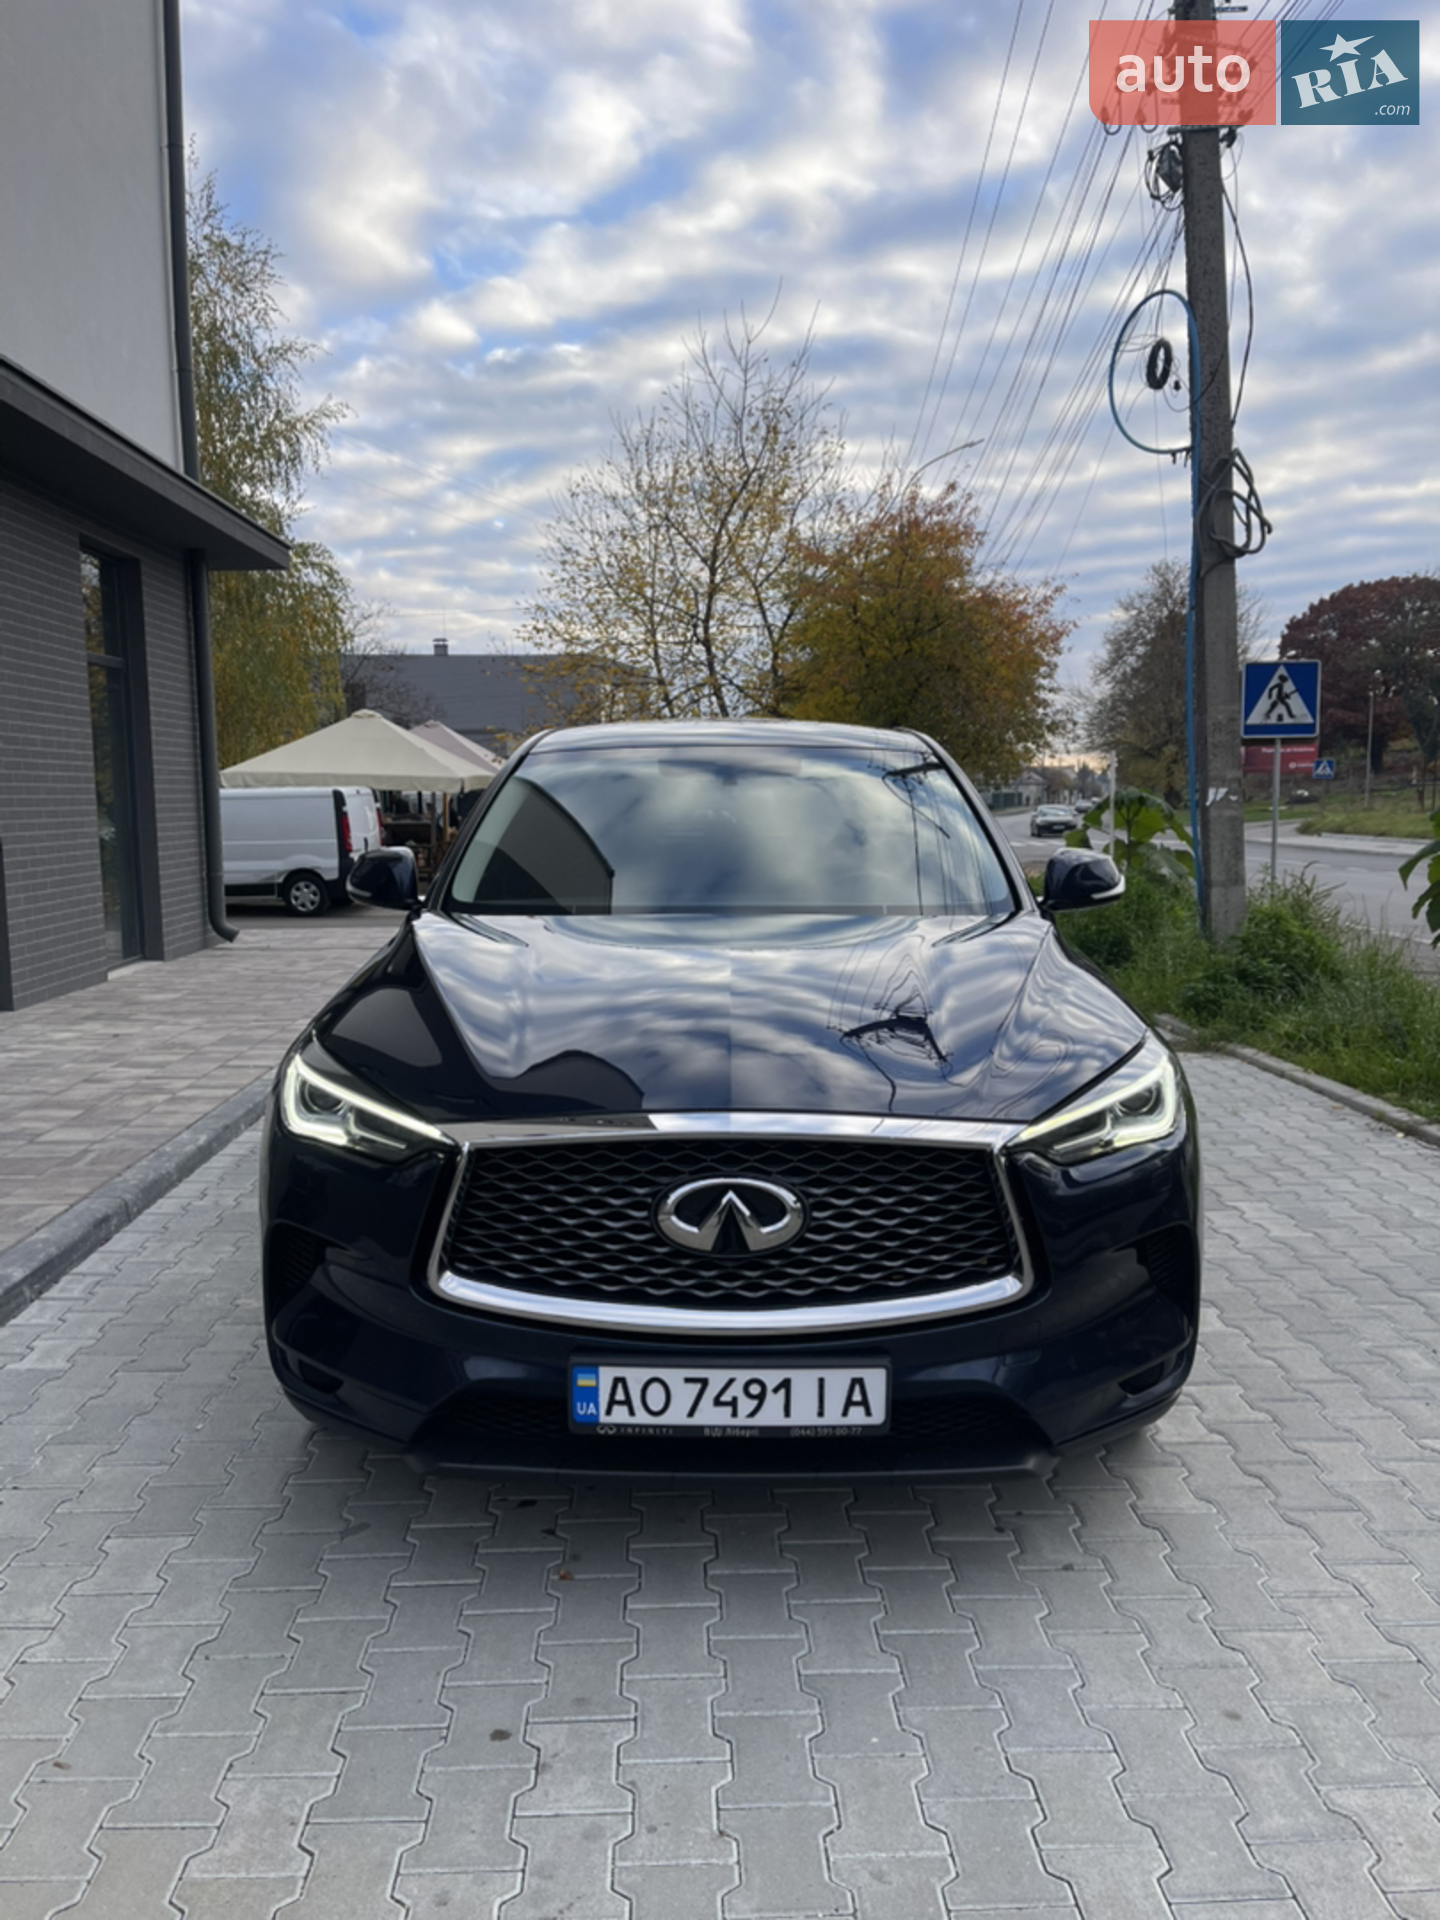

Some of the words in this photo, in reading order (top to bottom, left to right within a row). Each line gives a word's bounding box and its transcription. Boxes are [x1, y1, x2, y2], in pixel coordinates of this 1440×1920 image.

[604, 1376, 672, 1418] AO
[682, 1377, 792, 1419] 7491
[816, 1377, 873, 1418] IA
[577, 1403, 597, 1415] UA
[620, 1427, 673, 1435] INFINITI
